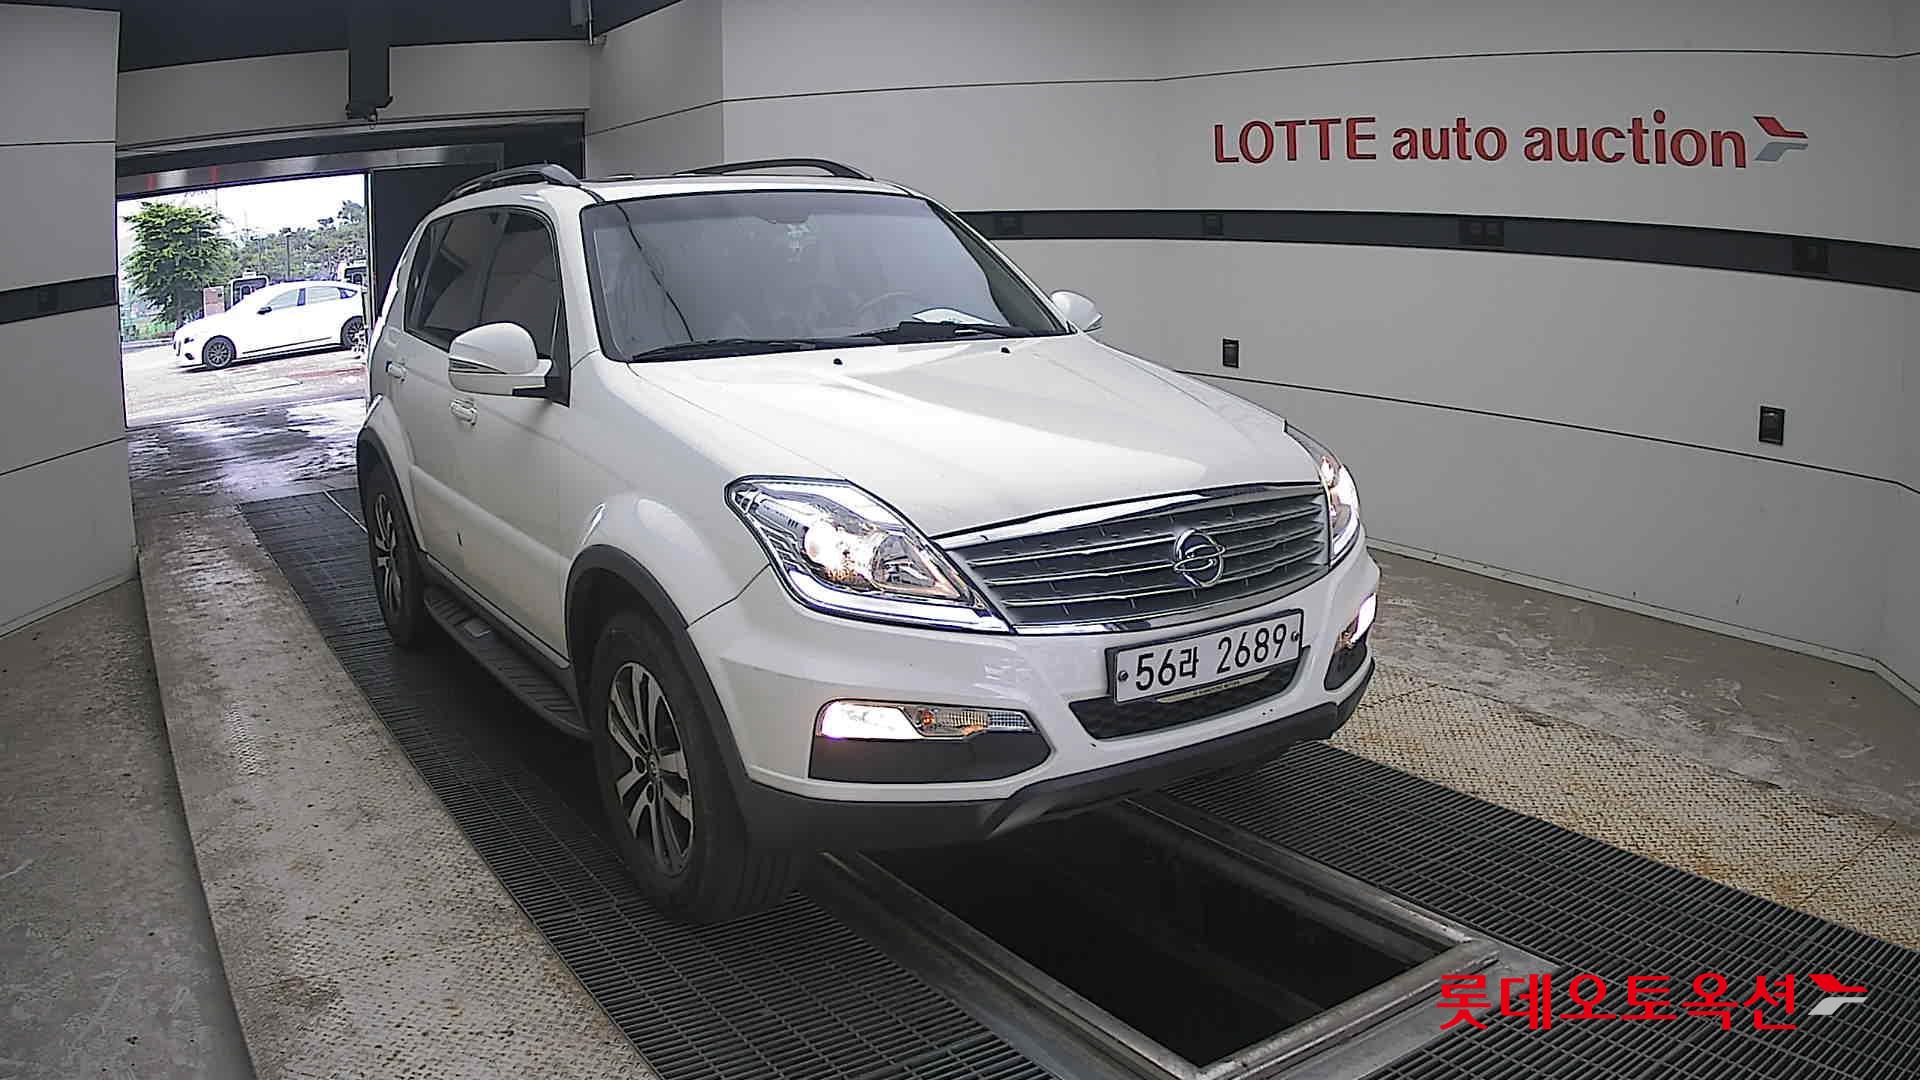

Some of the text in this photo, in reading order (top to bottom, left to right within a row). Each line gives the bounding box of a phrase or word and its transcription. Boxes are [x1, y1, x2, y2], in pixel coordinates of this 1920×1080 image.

[1213, 109, 1748, 169] LOTTE auto auction
[1136, 623, 1288, 690] 56라 2689
